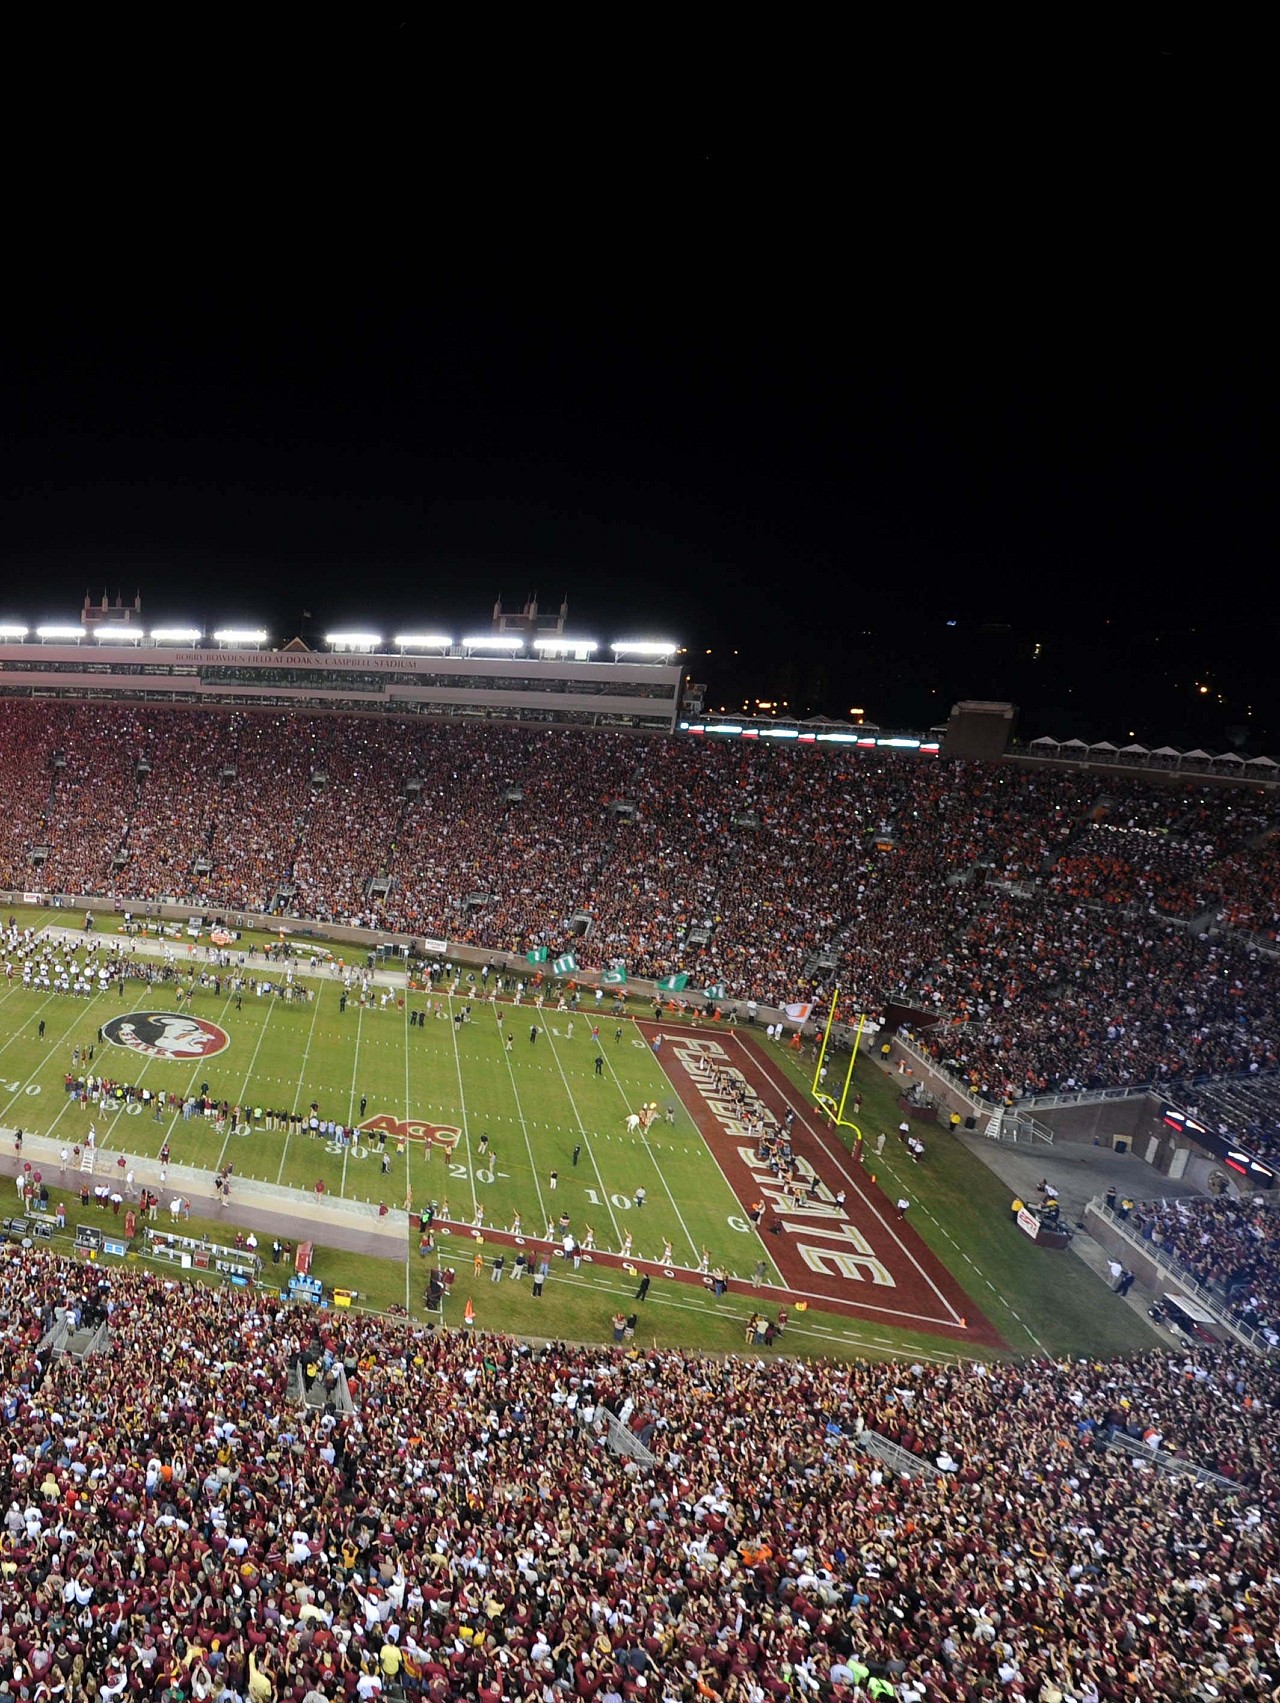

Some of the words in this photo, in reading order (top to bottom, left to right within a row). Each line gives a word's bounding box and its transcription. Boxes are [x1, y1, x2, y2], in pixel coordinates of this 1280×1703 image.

[176, 653, 202, 661] BOBBY
[206, 654, 245, 662] BOWDEN
[247, 655, 272, 663] FIELD
[286, 656, 312, 665] DOAK
[325, 657, 371, 667] CAMPBELL
[374, 659, 418, 669] STADIUM
[357, 1114, 461, 1148] ACC
[448, 1163, 495, 1184] 20
[584, 1189, 632, 1210] 10
